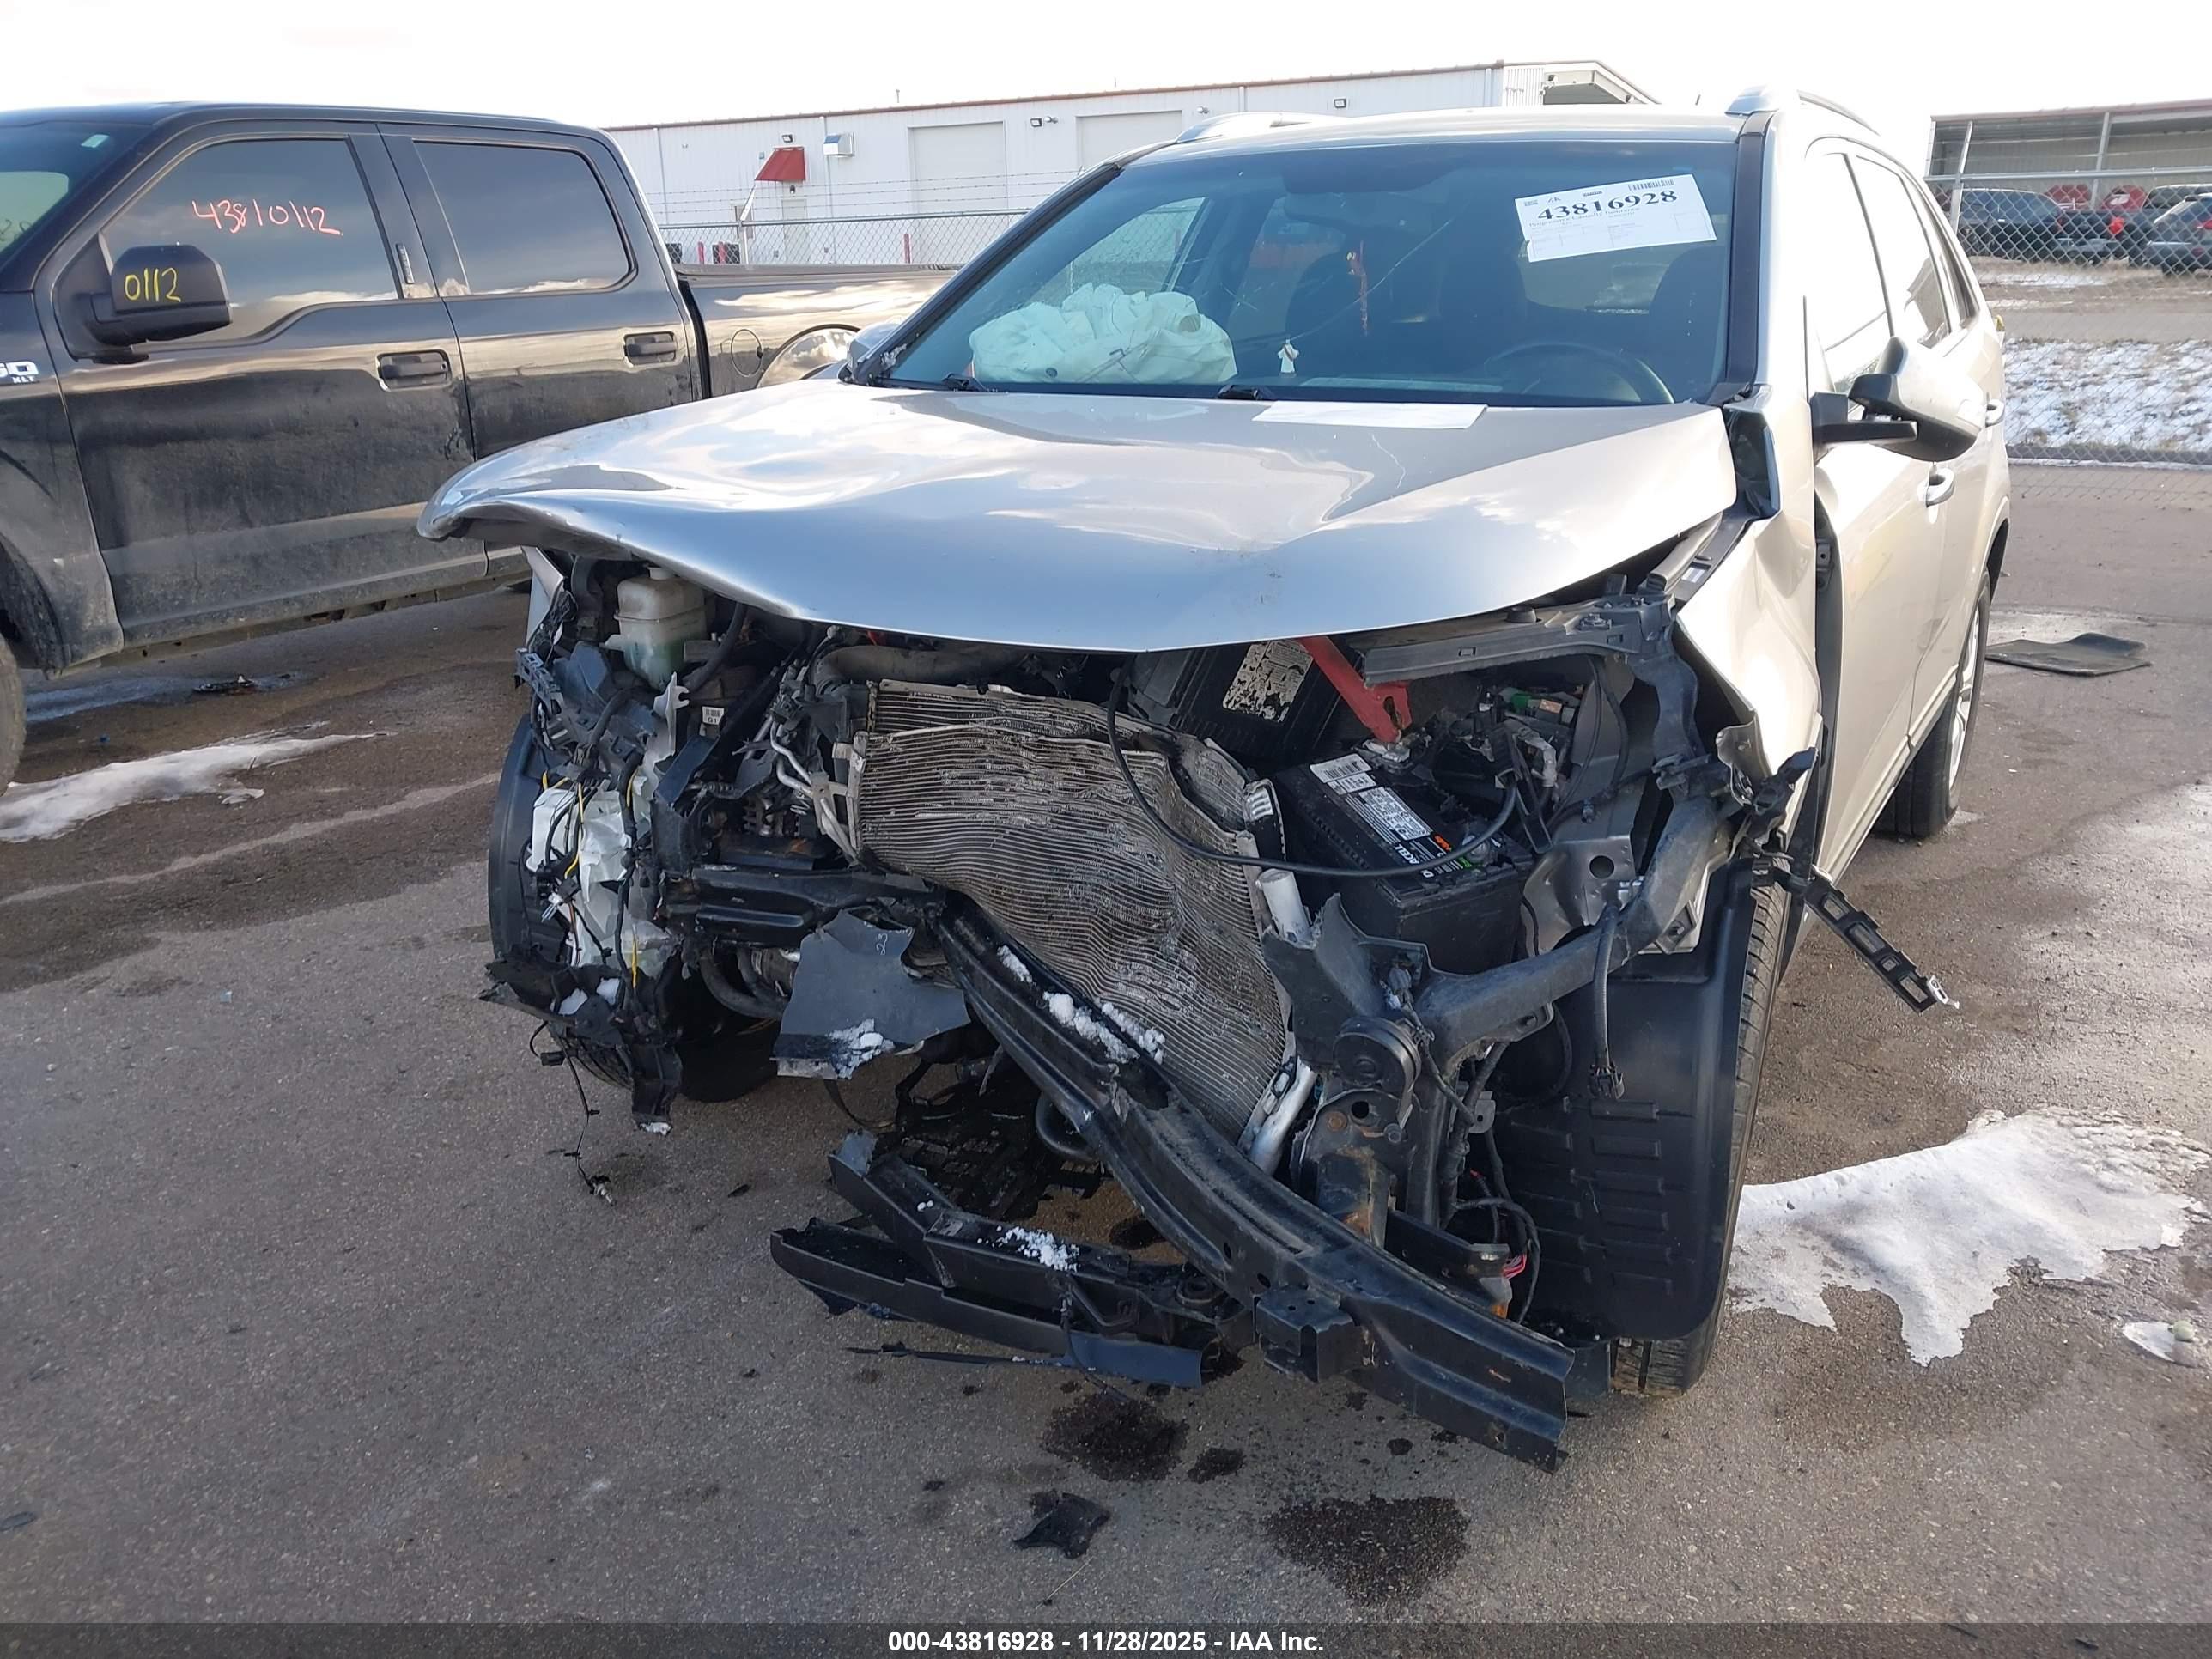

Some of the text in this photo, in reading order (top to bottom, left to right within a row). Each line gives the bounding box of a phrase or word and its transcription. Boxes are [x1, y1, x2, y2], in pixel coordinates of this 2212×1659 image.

[191, 198, 343, 235] 43810112
[1538, 190, 1677, 220] 43816928
[125, 267, 181, 303] 0112
